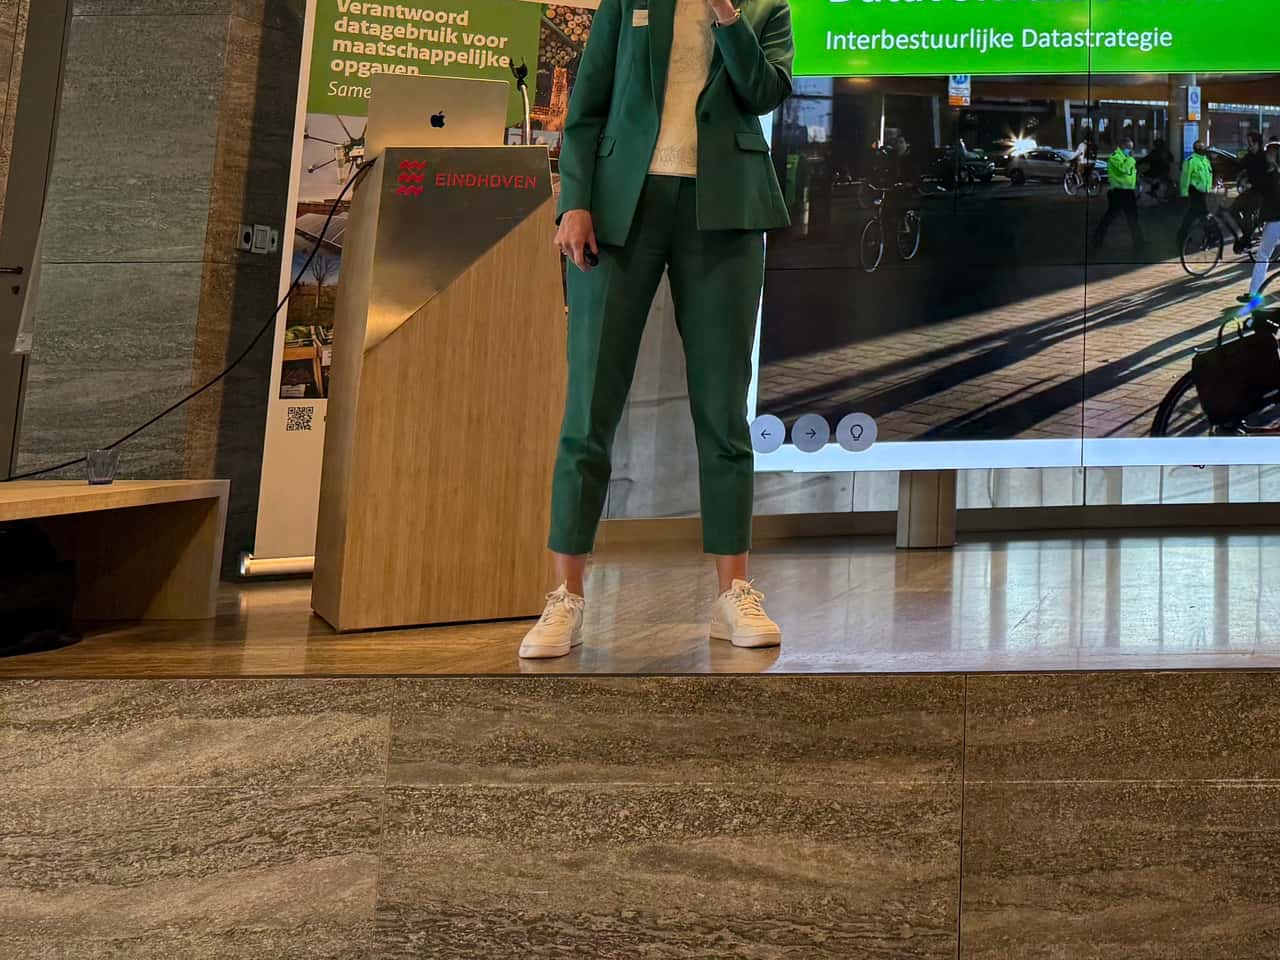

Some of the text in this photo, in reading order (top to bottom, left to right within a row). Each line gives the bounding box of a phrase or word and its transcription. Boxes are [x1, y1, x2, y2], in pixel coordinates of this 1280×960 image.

[334, 16, 508, 49] datagebruik voor
[826, 27, 1173, 53] Interbestuurlijke Datastrategie
[332, 39, 511, 69] maatschappelijke
[330, 58, 420, 78] opgaven
[435, 173, 537, 189] EINDHOVEN
